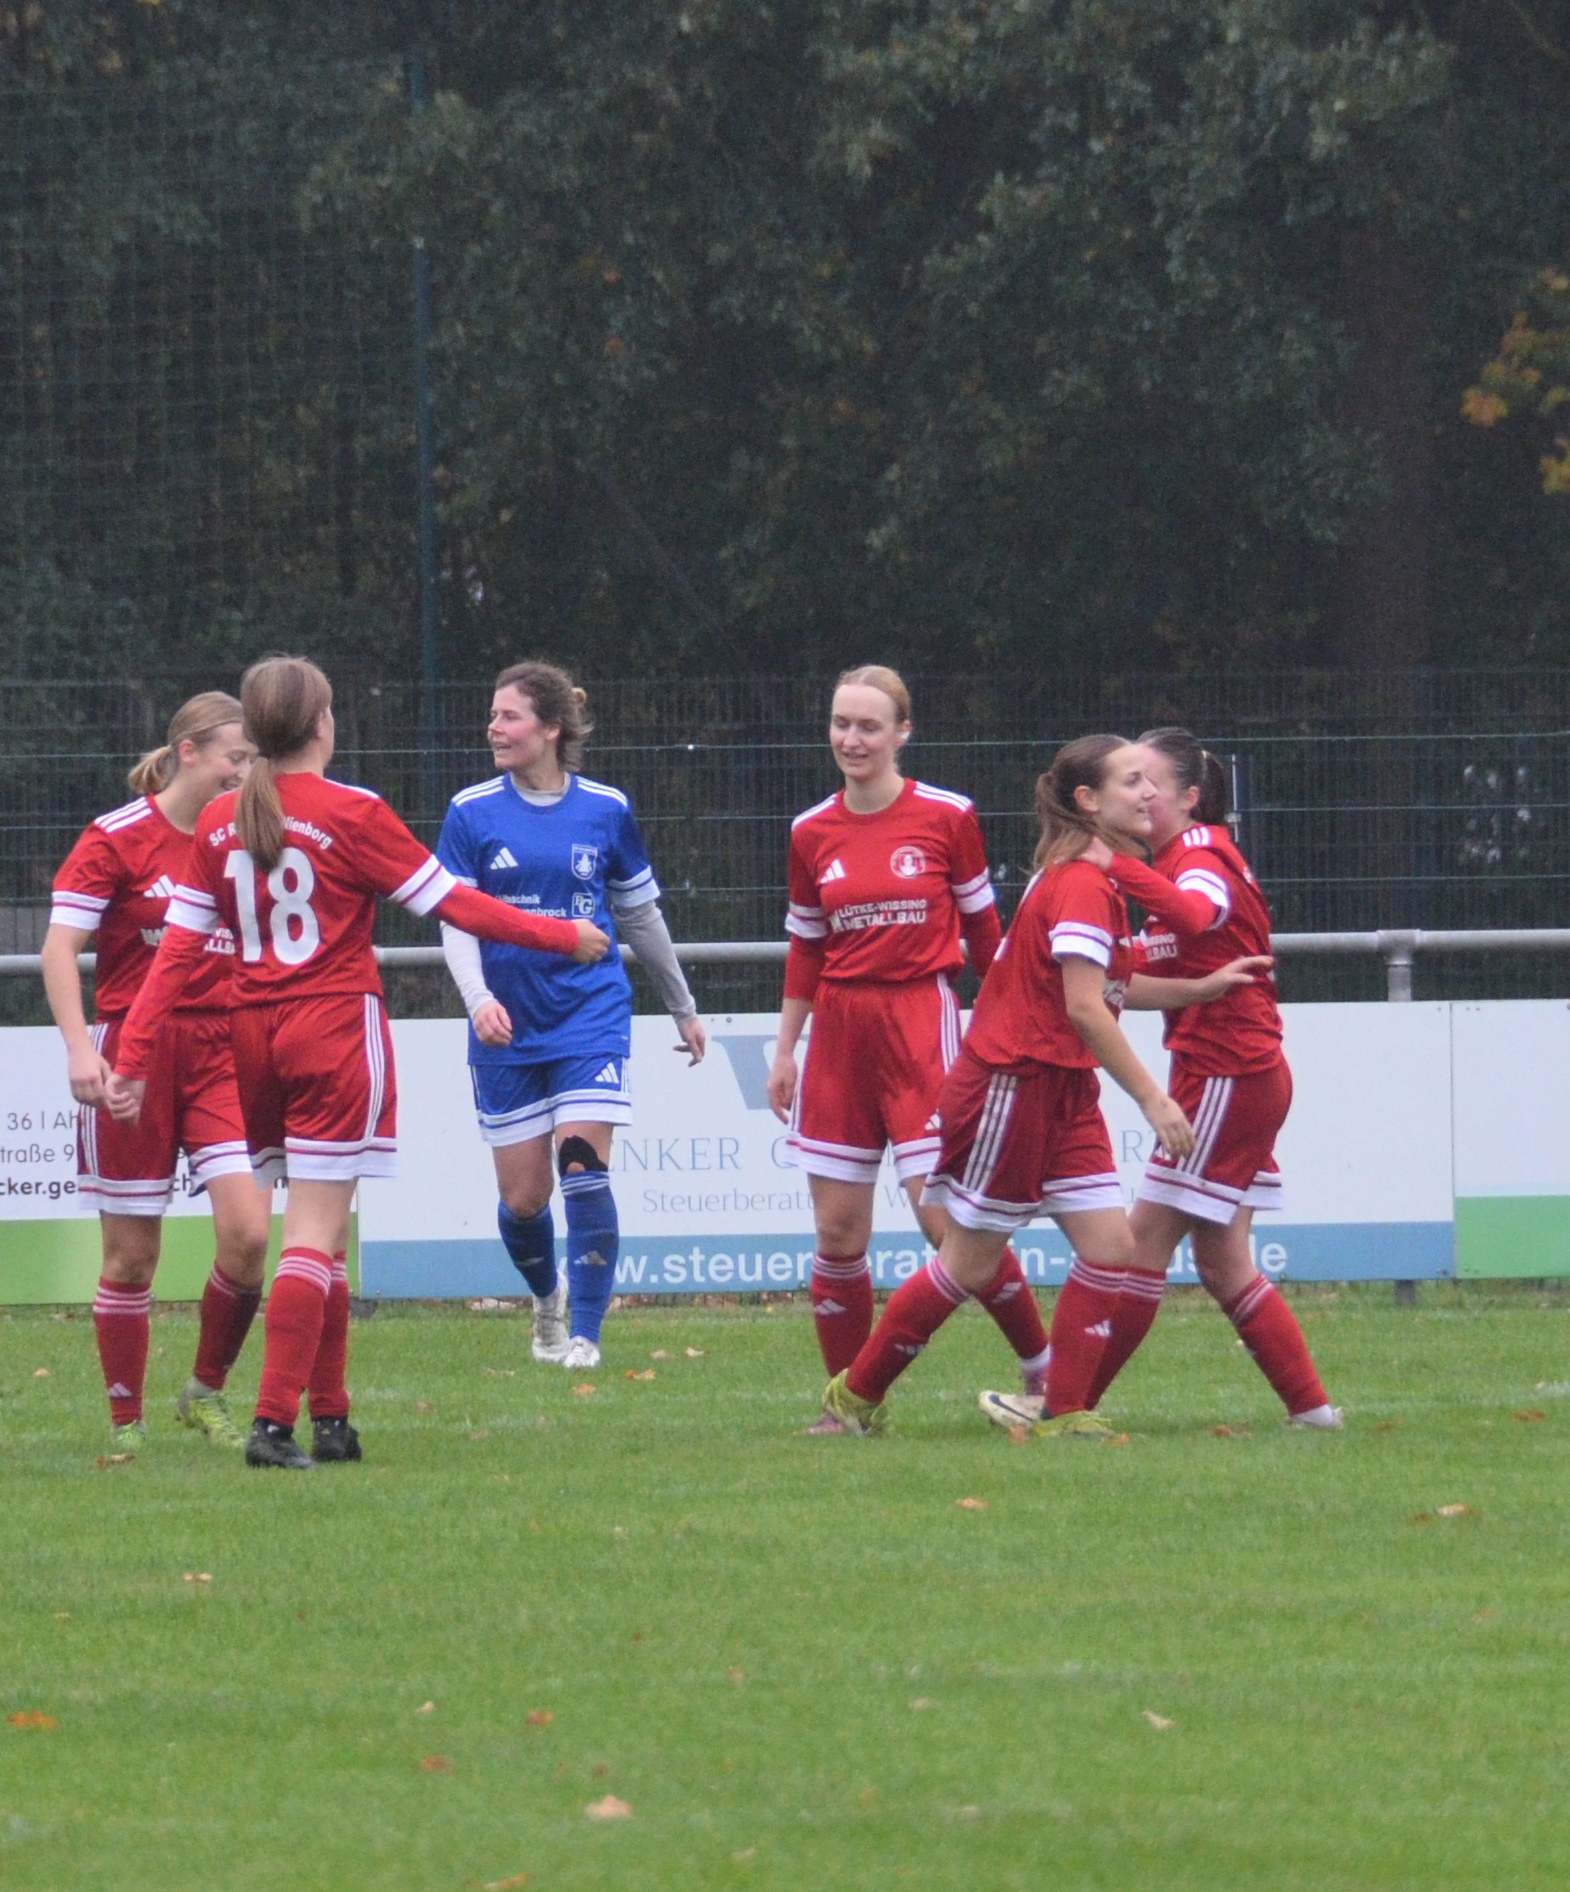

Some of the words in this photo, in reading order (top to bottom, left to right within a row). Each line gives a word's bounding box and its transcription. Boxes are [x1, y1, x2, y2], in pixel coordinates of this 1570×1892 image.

[283, 816, 333, 850] ienborg
[223, 847, 320, 965] 18
[842, 911, 927, 931] METALLBAU
[7, 1112, 33, 1131] 36
[608, 1136, 741, 1172] NKER
